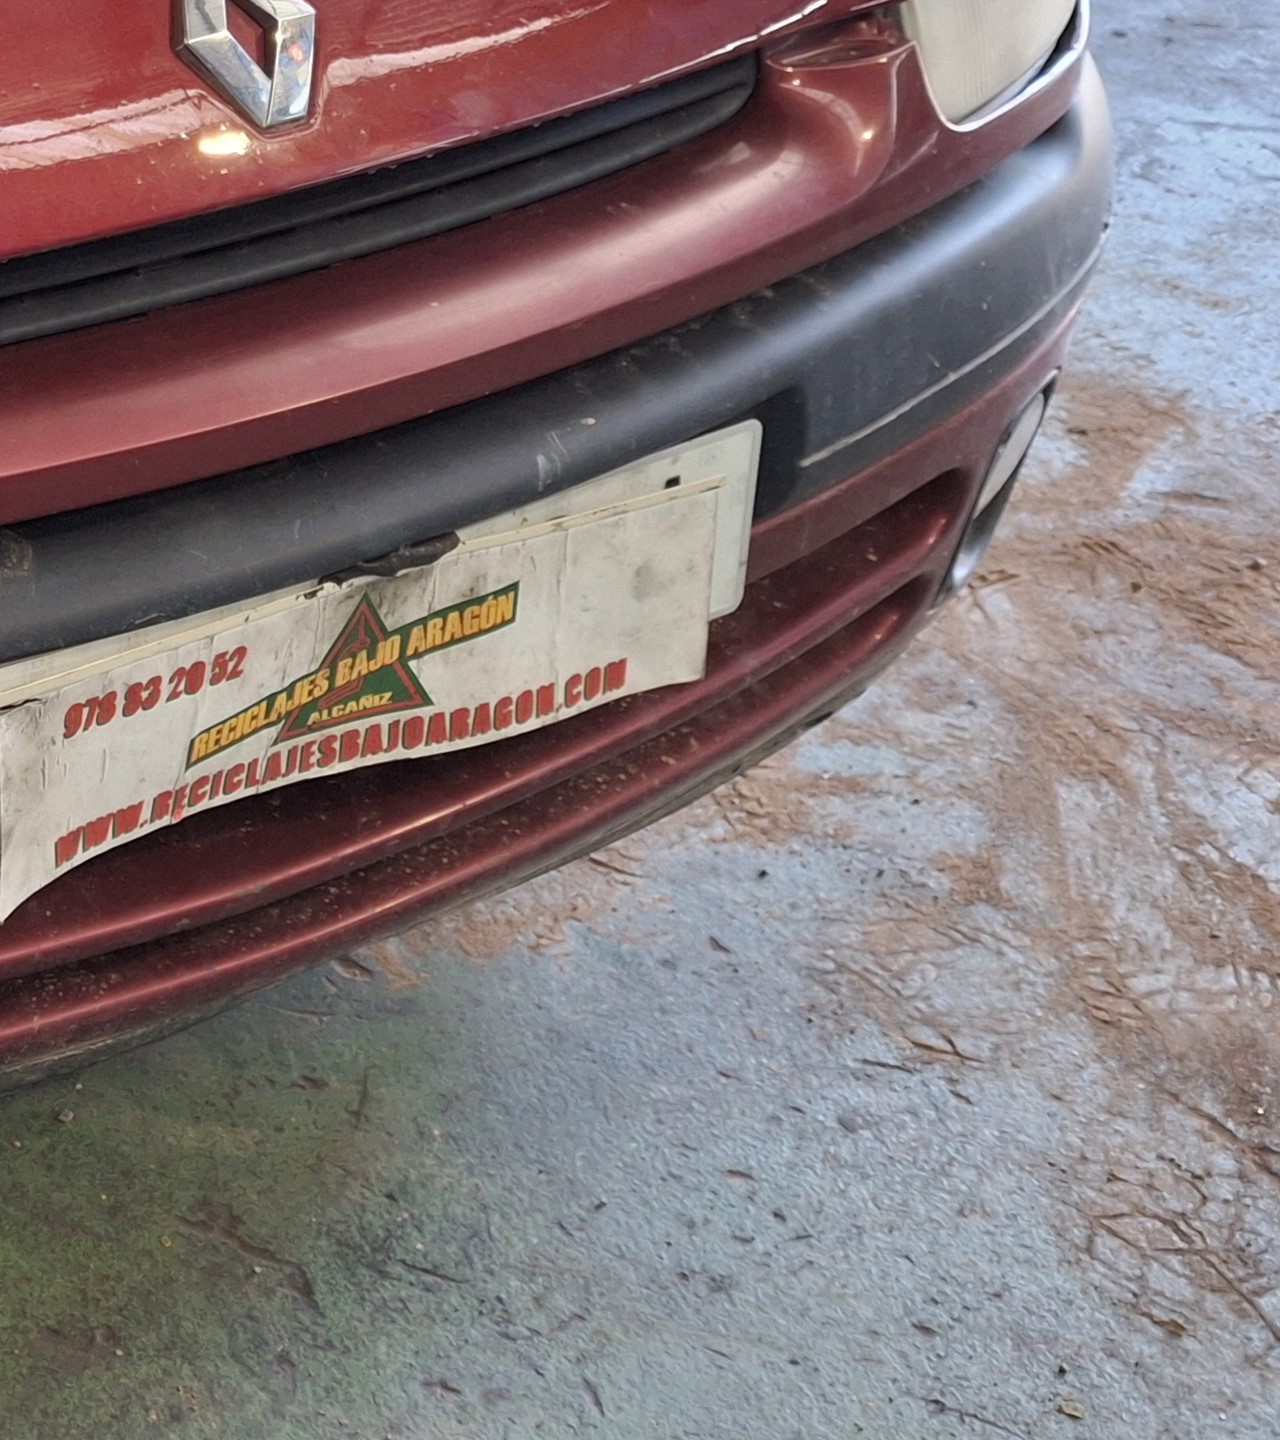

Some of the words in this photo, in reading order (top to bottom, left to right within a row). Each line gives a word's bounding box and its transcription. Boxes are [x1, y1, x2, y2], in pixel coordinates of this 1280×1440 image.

[63, 690, 118, 740] 978
[122, 674, 163, 718] 83
[165, 660, 207, 703] 20
[209, 645, 248, 687] 52
[190, 667, 331, 763] RECICLAJES
[334, 633, 402, 689] BAJO
[406, 591, 516, 657] ARAGÓN
[306, 691, 393, 726] ALCAÑIZ
[54, 657, 629, 869] WWW.RECICLAJESBAJOARAGON.COM
